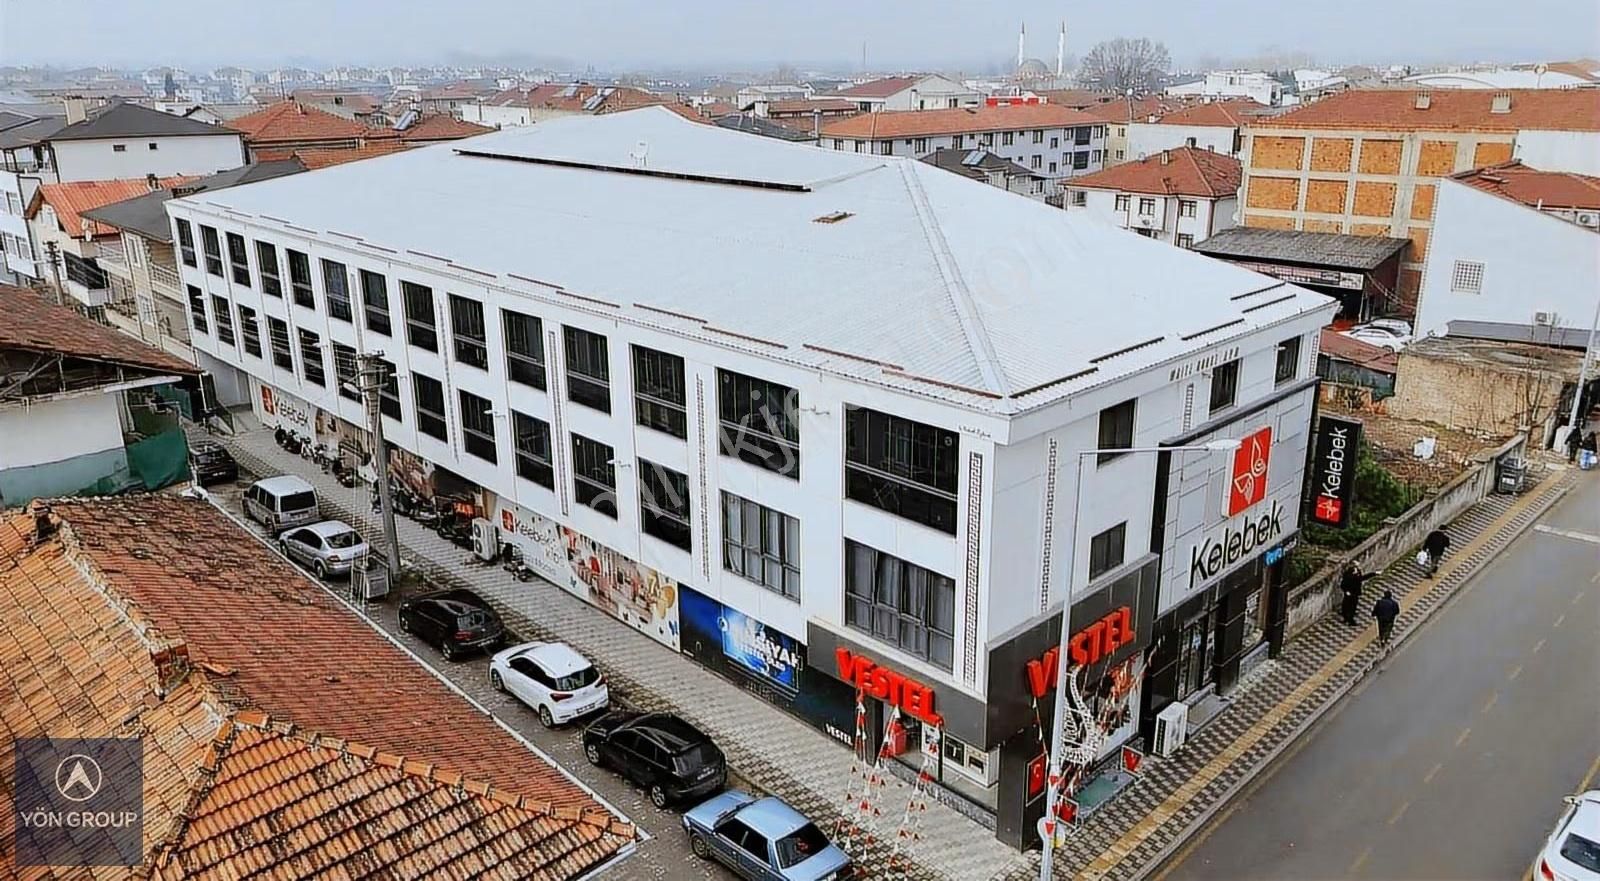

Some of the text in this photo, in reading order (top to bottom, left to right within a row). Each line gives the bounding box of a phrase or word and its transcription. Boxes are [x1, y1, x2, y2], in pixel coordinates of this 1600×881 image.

[1321, 426, 1348, 499] Kelebek
[1189, 500, 1283, 589] Kelebek
[835, 647, 944, 726] VESTEL
[825, 723, 854, 746] VESTEL
